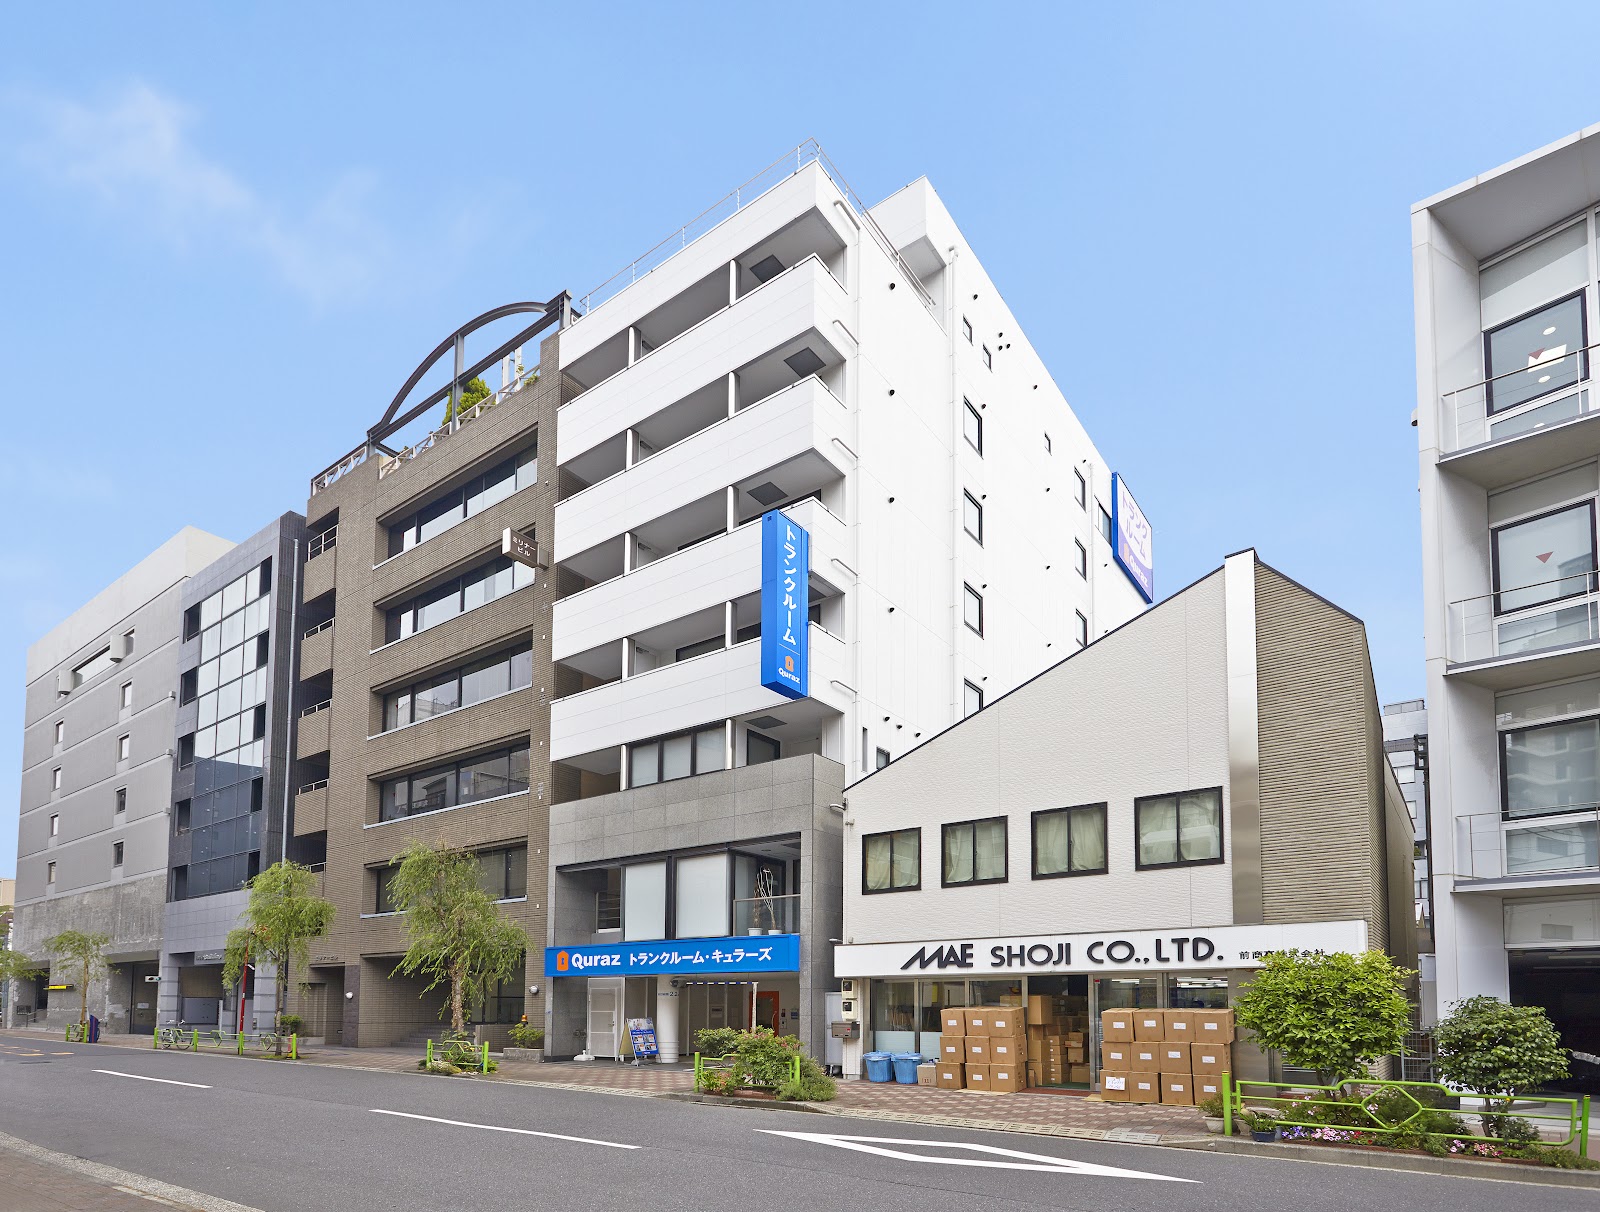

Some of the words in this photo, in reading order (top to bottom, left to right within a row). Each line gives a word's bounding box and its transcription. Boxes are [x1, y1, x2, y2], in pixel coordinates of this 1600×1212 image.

[1122, 490, 1148, 539] トランク
[1126, 518, 1146, 561] ルーム
[782, 525, 797, 646] トランクルーム
[1129, 554, 1149, 588] Quraz
[778, 667, 800, 684] Quraz
[571, 953, 621, 970] Quraz
[629, 947, 773, 966] トランクルーム・キュラーズ
[900, 943, 974, 970] MAE
[990, 943, 1072, 967] SHOJI
